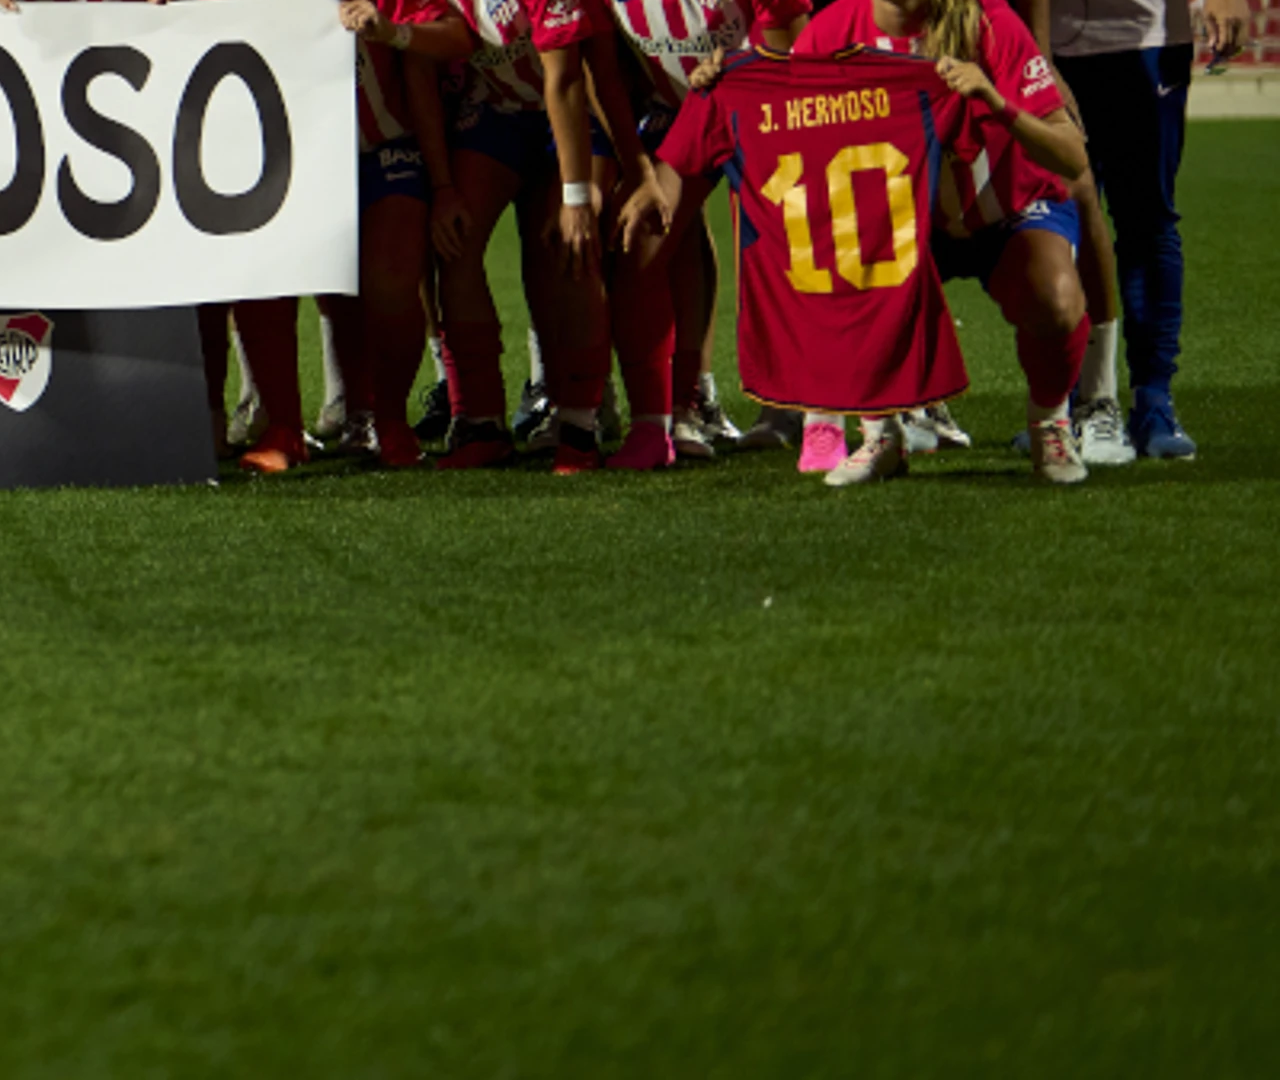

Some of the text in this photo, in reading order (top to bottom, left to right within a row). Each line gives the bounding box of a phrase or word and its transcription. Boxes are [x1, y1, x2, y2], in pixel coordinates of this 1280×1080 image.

[758, 87, 891, 133] J. HERMOSO
[760, 142, 919, 294] 10
